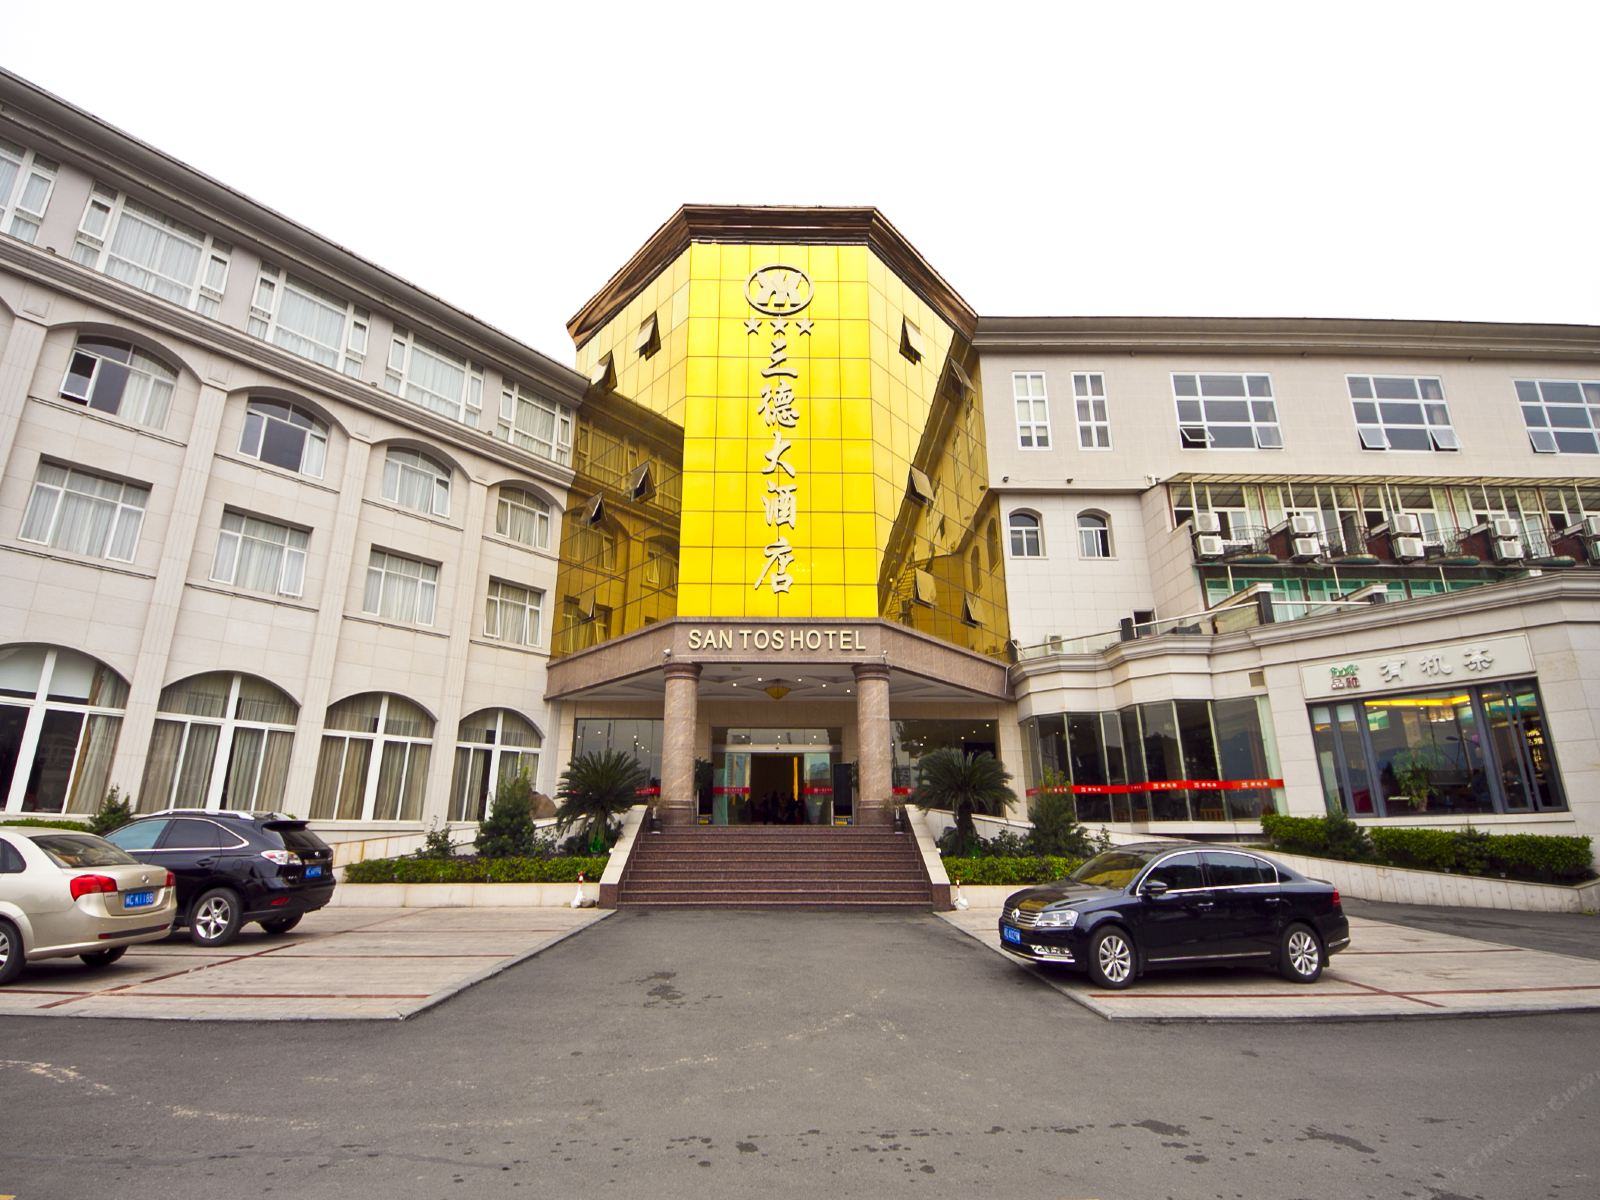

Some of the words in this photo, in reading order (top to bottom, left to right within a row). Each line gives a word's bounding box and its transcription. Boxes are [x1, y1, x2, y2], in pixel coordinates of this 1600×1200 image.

[754, 338, 800, 595] 三德大酒店
[790, 629, 867, 651] HOTEL
[1379, 648, 1495, 683] 有机茶
